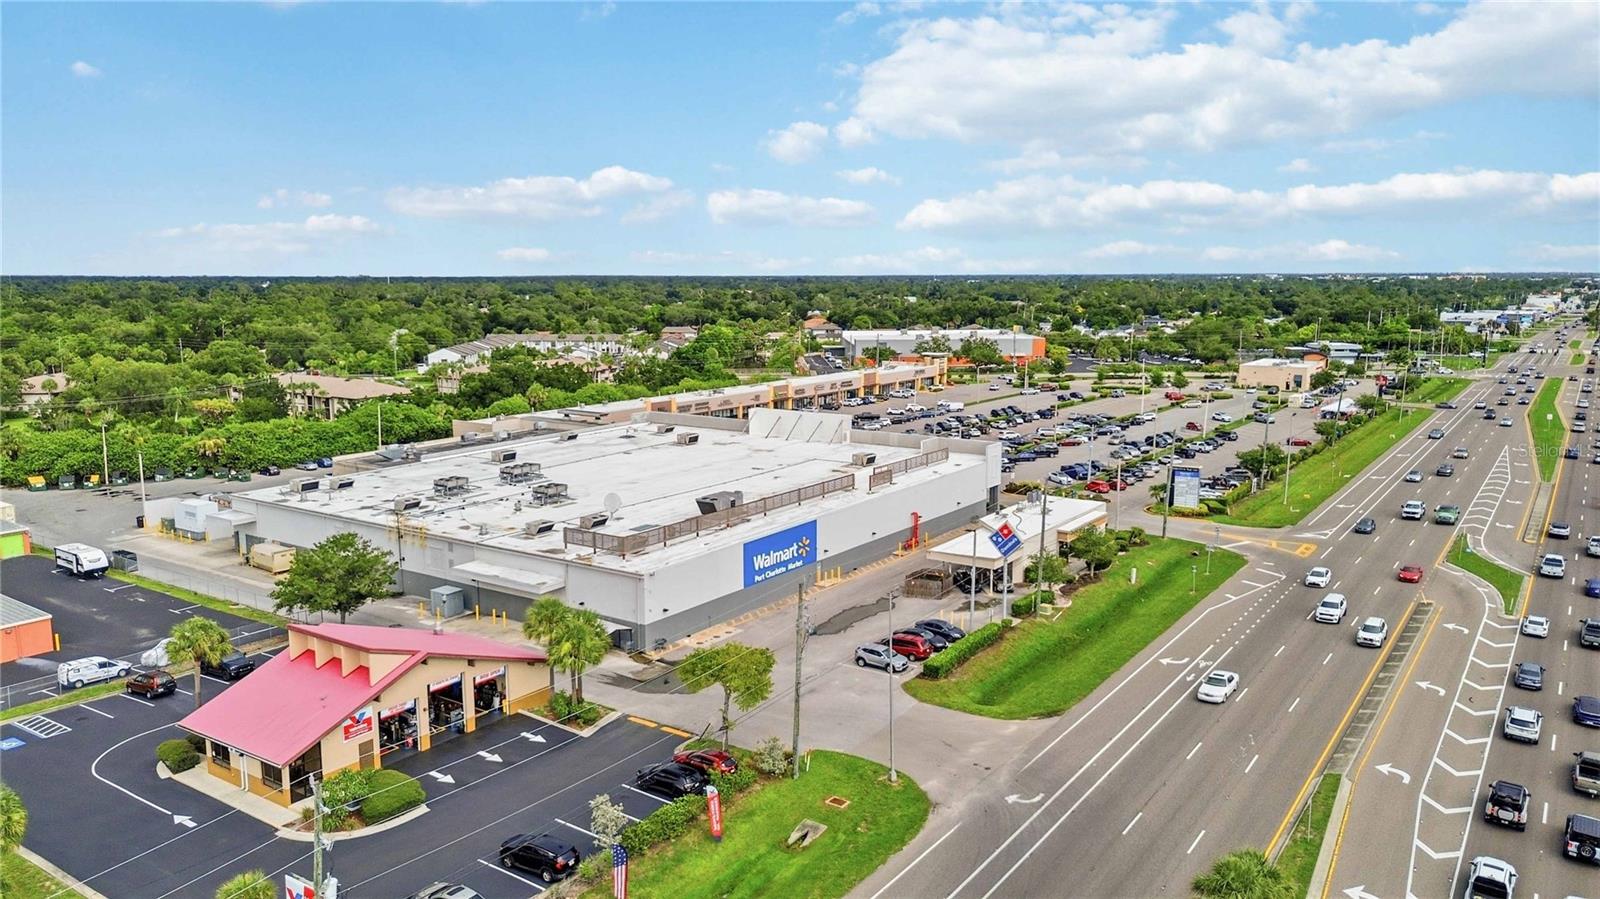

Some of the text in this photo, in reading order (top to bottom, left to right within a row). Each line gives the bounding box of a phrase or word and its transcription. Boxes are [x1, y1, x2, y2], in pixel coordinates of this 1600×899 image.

[753, 542, 798, 570] Walmart
[755, 560, 803, 583] Port Charlotte Market
